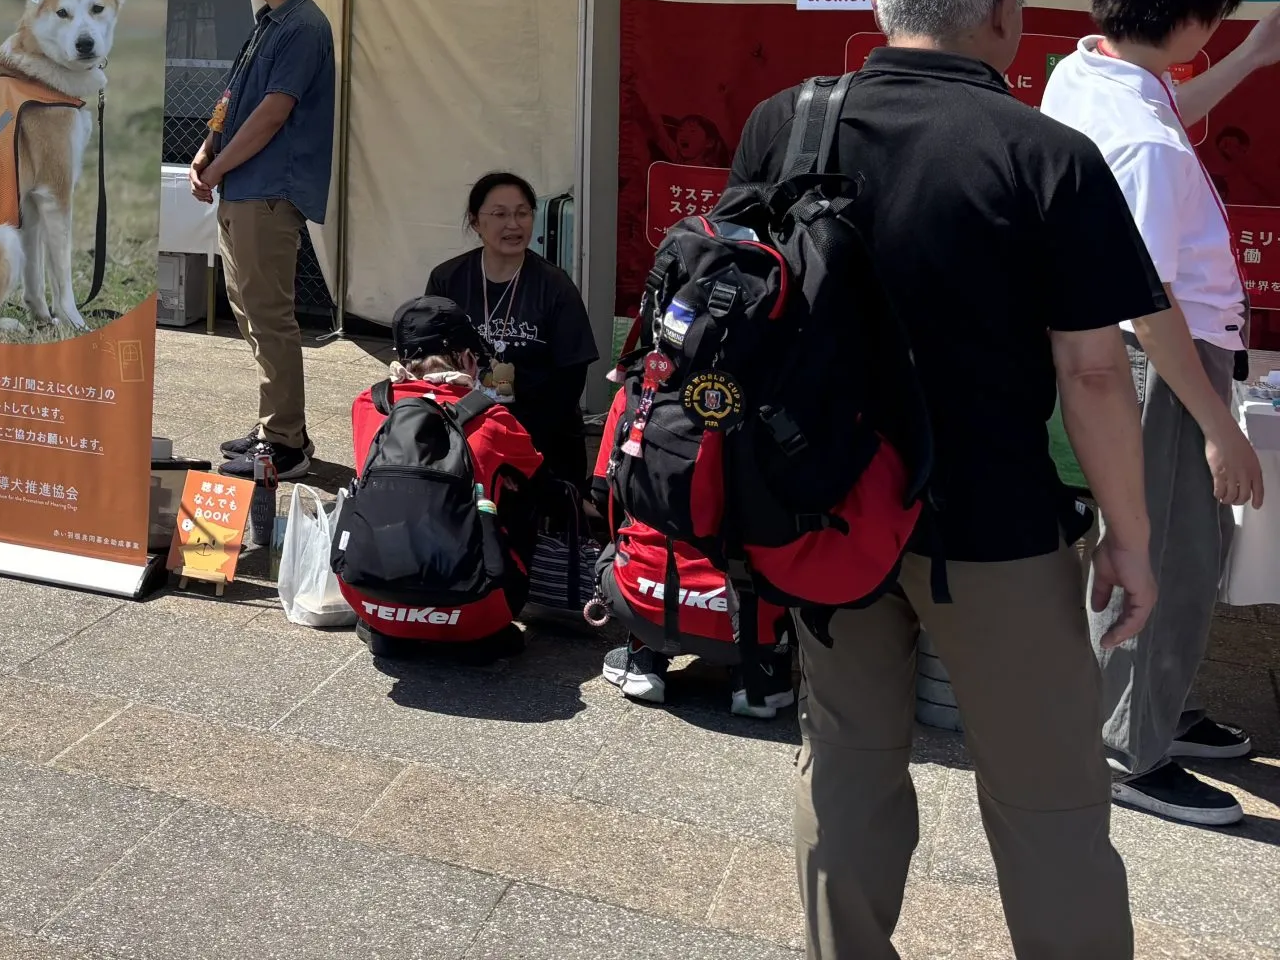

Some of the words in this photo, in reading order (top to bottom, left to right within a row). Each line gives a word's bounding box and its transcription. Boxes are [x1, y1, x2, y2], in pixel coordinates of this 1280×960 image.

[669, 184, 721, 201] サステ
[1240, 230, 1280, 246] ミリ
[684, 384, 694, 408] CLUB
[692, 373, 726, 384] WORLD
[727, 382, 741, 399] CUP
[704, 420, 719, 428] FIFA
[201, 481, 237, 496] 聴導犬
[193, 493, 237, 511] なんでも
[194, 507, 231, 523] BOOK
